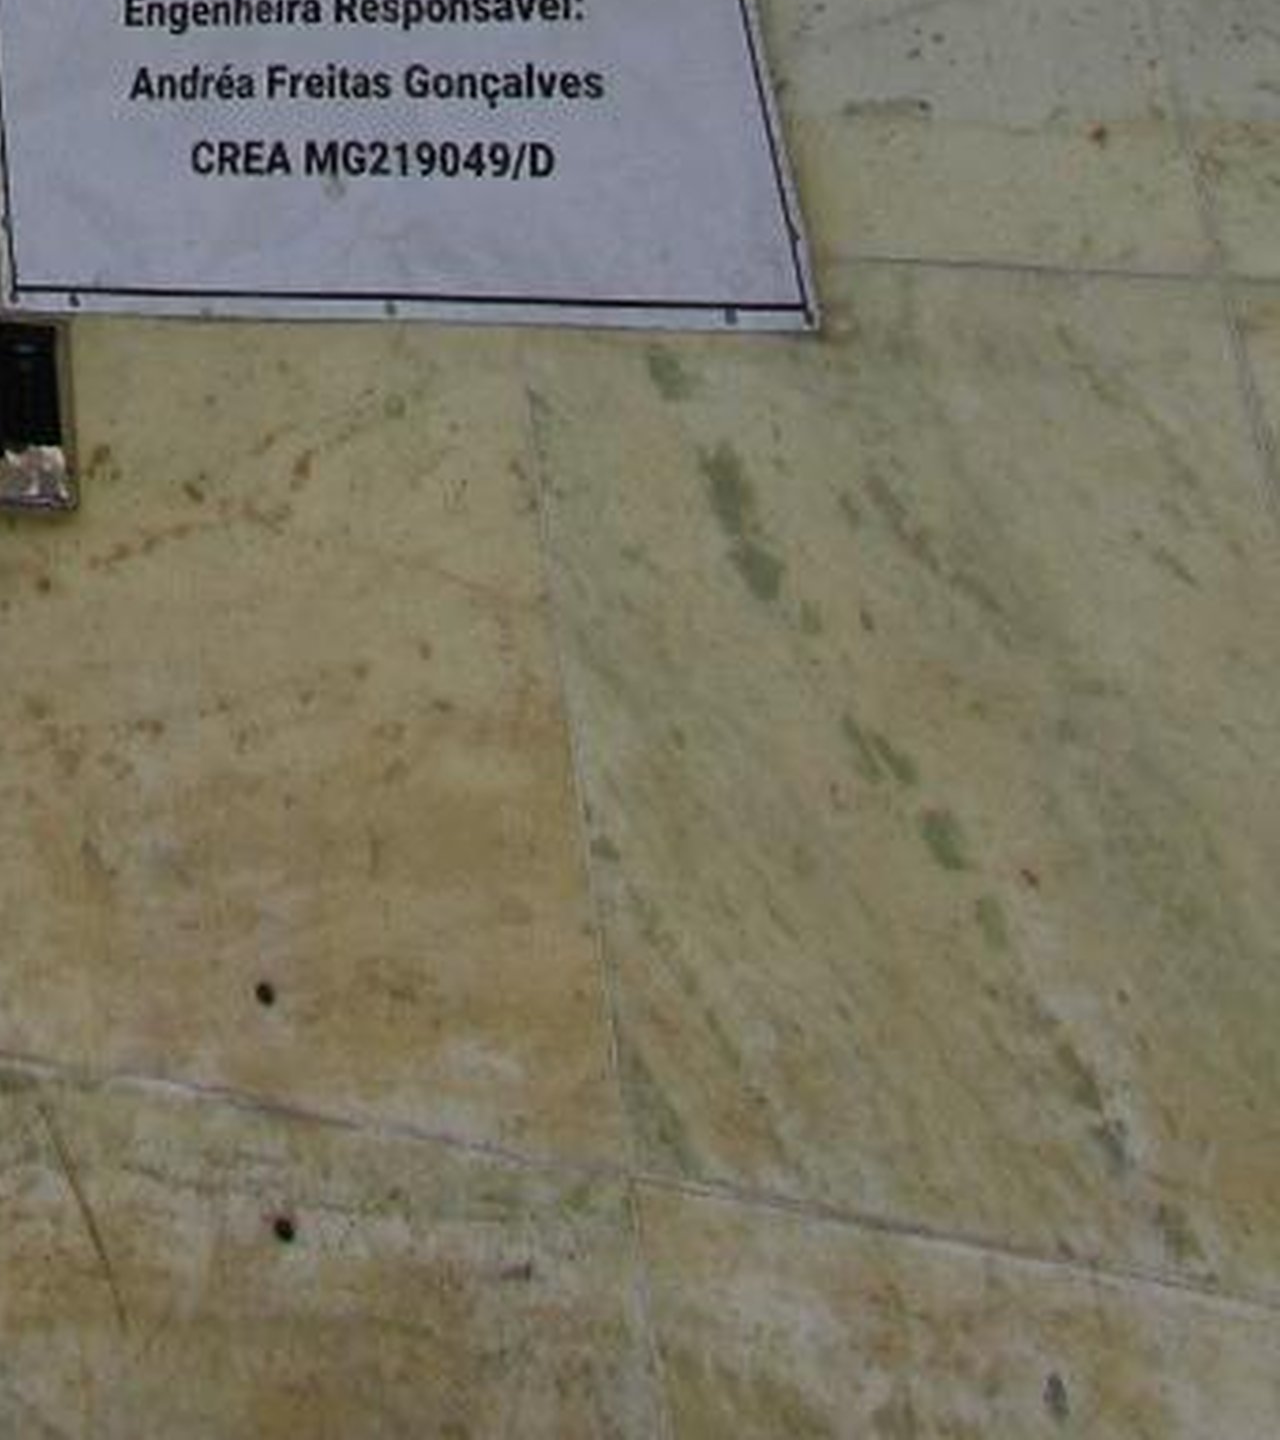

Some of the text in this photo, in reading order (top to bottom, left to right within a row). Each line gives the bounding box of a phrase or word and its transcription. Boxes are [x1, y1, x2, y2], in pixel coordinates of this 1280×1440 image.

[130, 64, 604, 108] Andréa Freitas Gonçalves
[190, 140, 555, 180] CREA MG219049/D
